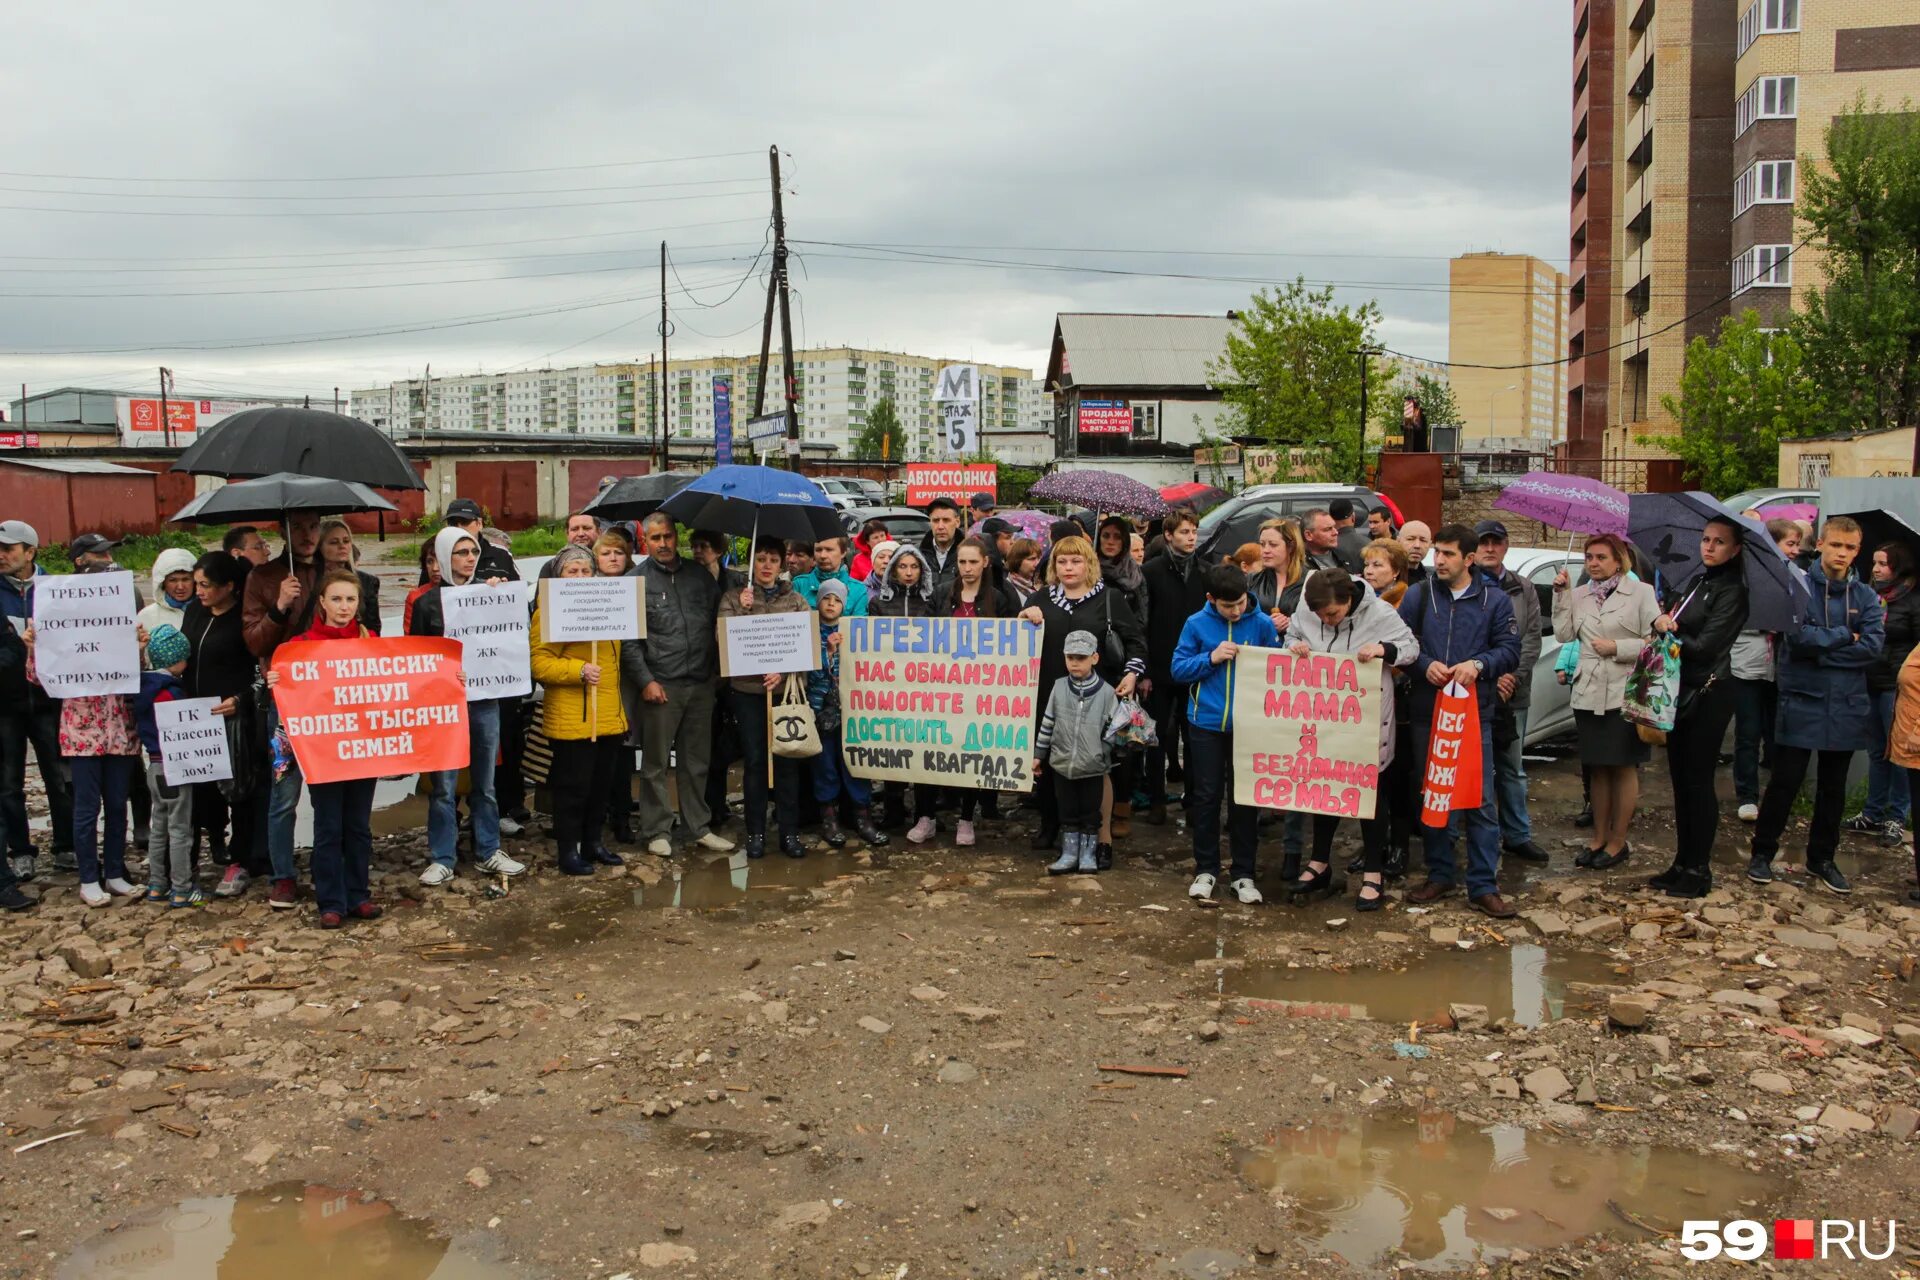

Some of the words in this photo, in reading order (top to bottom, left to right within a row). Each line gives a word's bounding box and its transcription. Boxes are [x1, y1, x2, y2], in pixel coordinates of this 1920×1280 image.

[941, 368, 972, 398] М
[945, 404, 972, 418] ЭТАЖ
[1081, 410, 1130, 418] ПРОДАЖА
[951, 420, 966, 450] 5
[907, 470, 997, 486] АВТОСТОЯНКА
[916, 491, 989, 499] КРУГЛОСУТОЧ
[49, 585, 120, 599] ТРЕБУЕМ
[456, 594, 515, 608] ТРЕБУЕМ
[39, 615, 133, 632] ДОСТРОИТЬ
[448, 622, 523, 638] ДОСТРОИТЬ
[75, 641, 101, 654] ЖК
[850, 618, 1042, 660] ПРЕЗИДЕНТ
[477, 647, 498, 658] ЖК
[48, 671, 130, 685] «ТРИУМФ»
[291, 661, 320, 681] СК
[855, 660, 896, 682] НАС
[1266, 653, 1367, 698] ПАПА,
[468, 675, 522, 687] РИУМФ»
[333, 682, 409, 706] КИНУЛ
[850, 689, 964, 714] ПОМОГИТЕ
[976, 694, 1031, 718] НАМ
[1264, 689, 1362, 724] МАМА
[178, 708, 199, 722] ГК
[286, 712, 359, 737] БОЛЕЕ
[365, 704, 460, 730] ТЫСЯЧИ
[163, 728, 223, 742] Классик
[845, 717, 953, 745] ДОСТРОИТЬ
[961, 722, 1029, 751] ДОМА
[168, 751, 190, 761] где
[194, 743, 222, 758] мой
[338, 731, 414, 760] СЕМЕЙ
[182, 762, 214, 778] дом?
[923, 750, 1008, 777] КВАРТАЛ
[1011, 757, 1027, 780] 2
